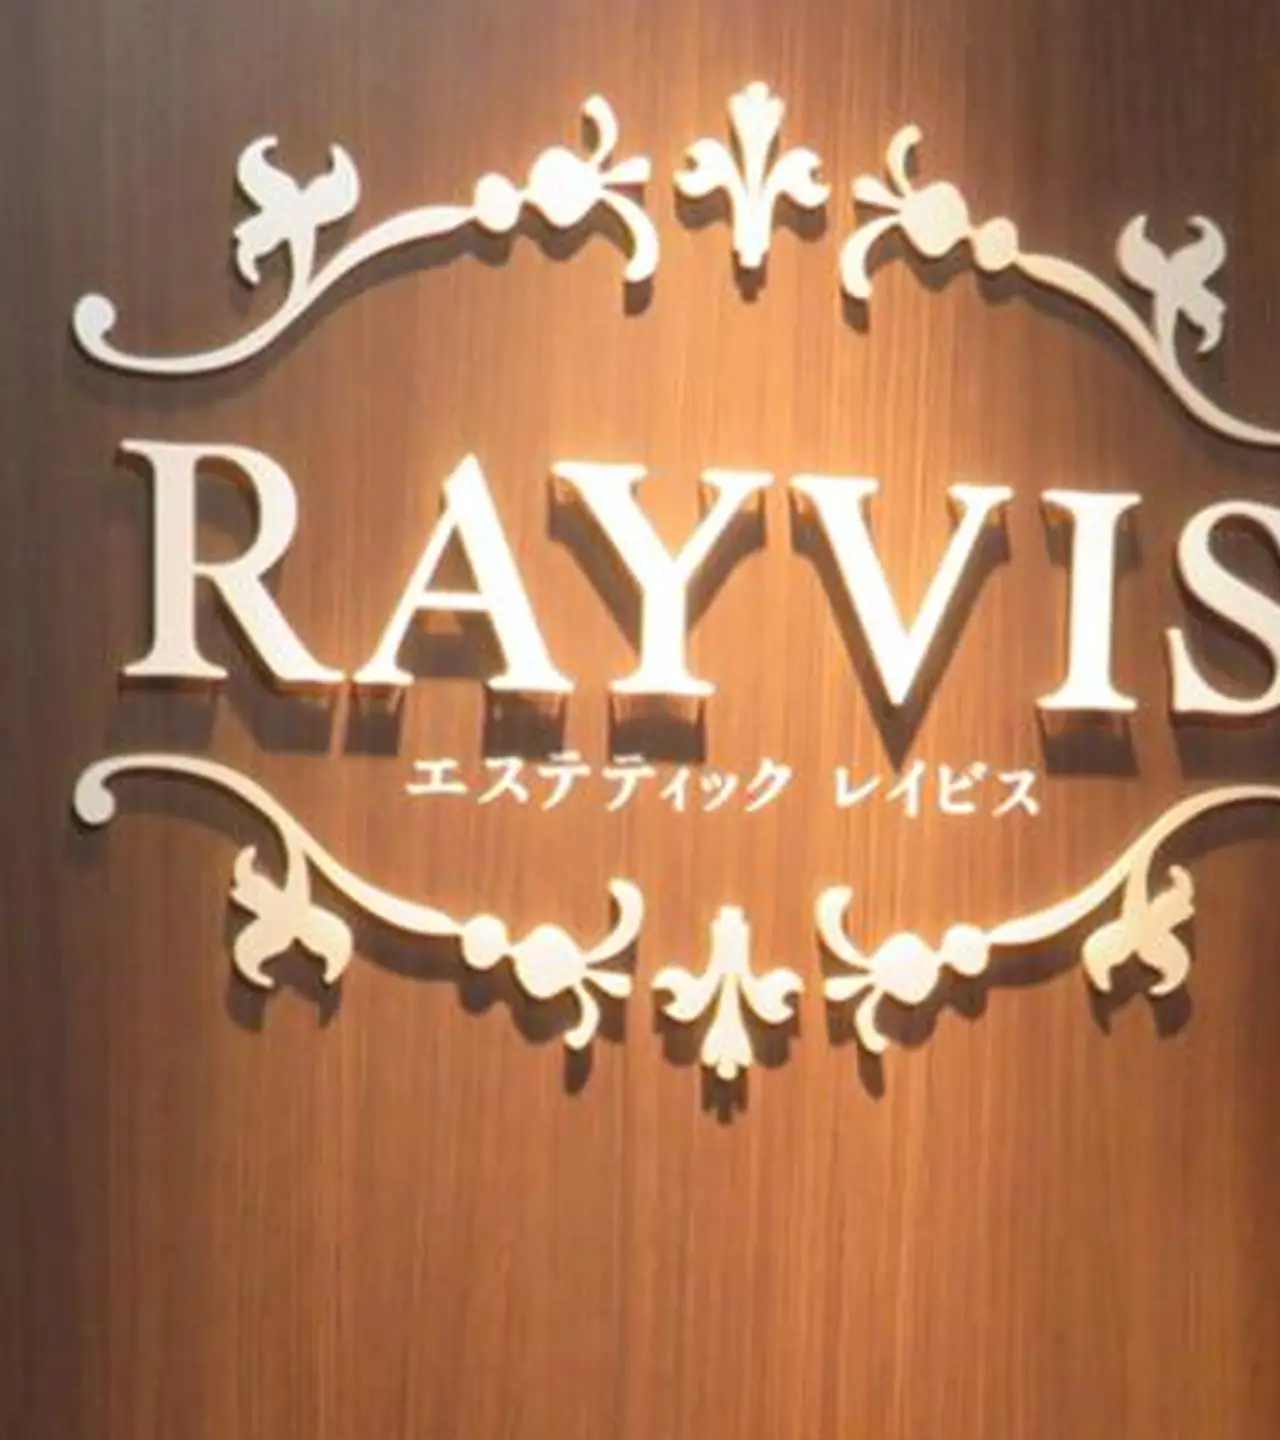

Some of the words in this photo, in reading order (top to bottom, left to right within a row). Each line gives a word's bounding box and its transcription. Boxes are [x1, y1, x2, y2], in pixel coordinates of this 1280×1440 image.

[405, 752, 792, 813] エステティック
[832, 759, 1042, 817] レイビス
